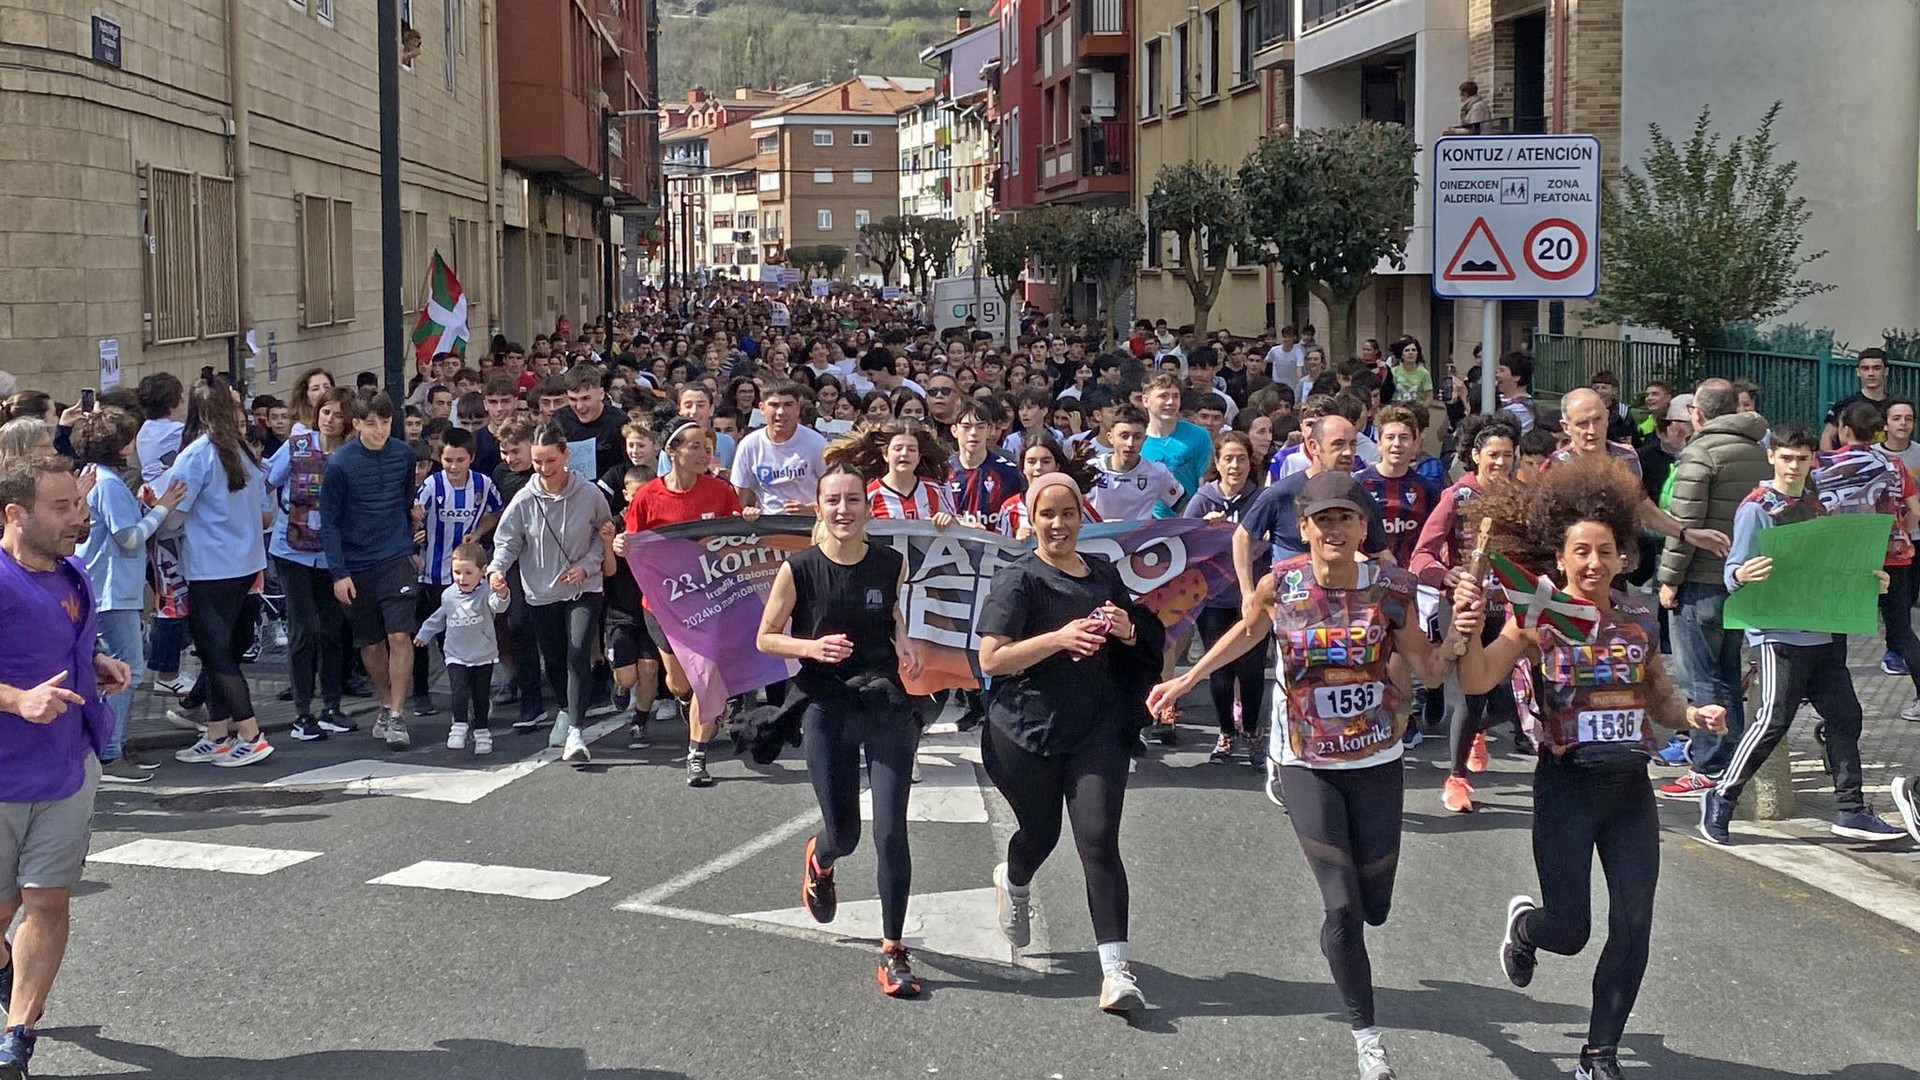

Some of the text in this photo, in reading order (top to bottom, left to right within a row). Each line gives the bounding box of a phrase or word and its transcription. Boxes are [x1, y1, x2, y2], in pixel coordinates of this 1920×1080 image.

[1443, 148, 1503, 162] KONTUZ
[1516, 144, 1592, 161] ATENCIÓN
[1440, 180, 1499, 190] OINEZKOEN
[1547, 179, 1580, 189] ZONA
[1443, 194, 1495, 203] ALDERDIA
[1533, 193, 1592, 202] PEATONAL
[1538, 238, 1573, 261] 20
[449, 615, 485, 628] adidas
[1588, 711, 1635, 741] 1536
